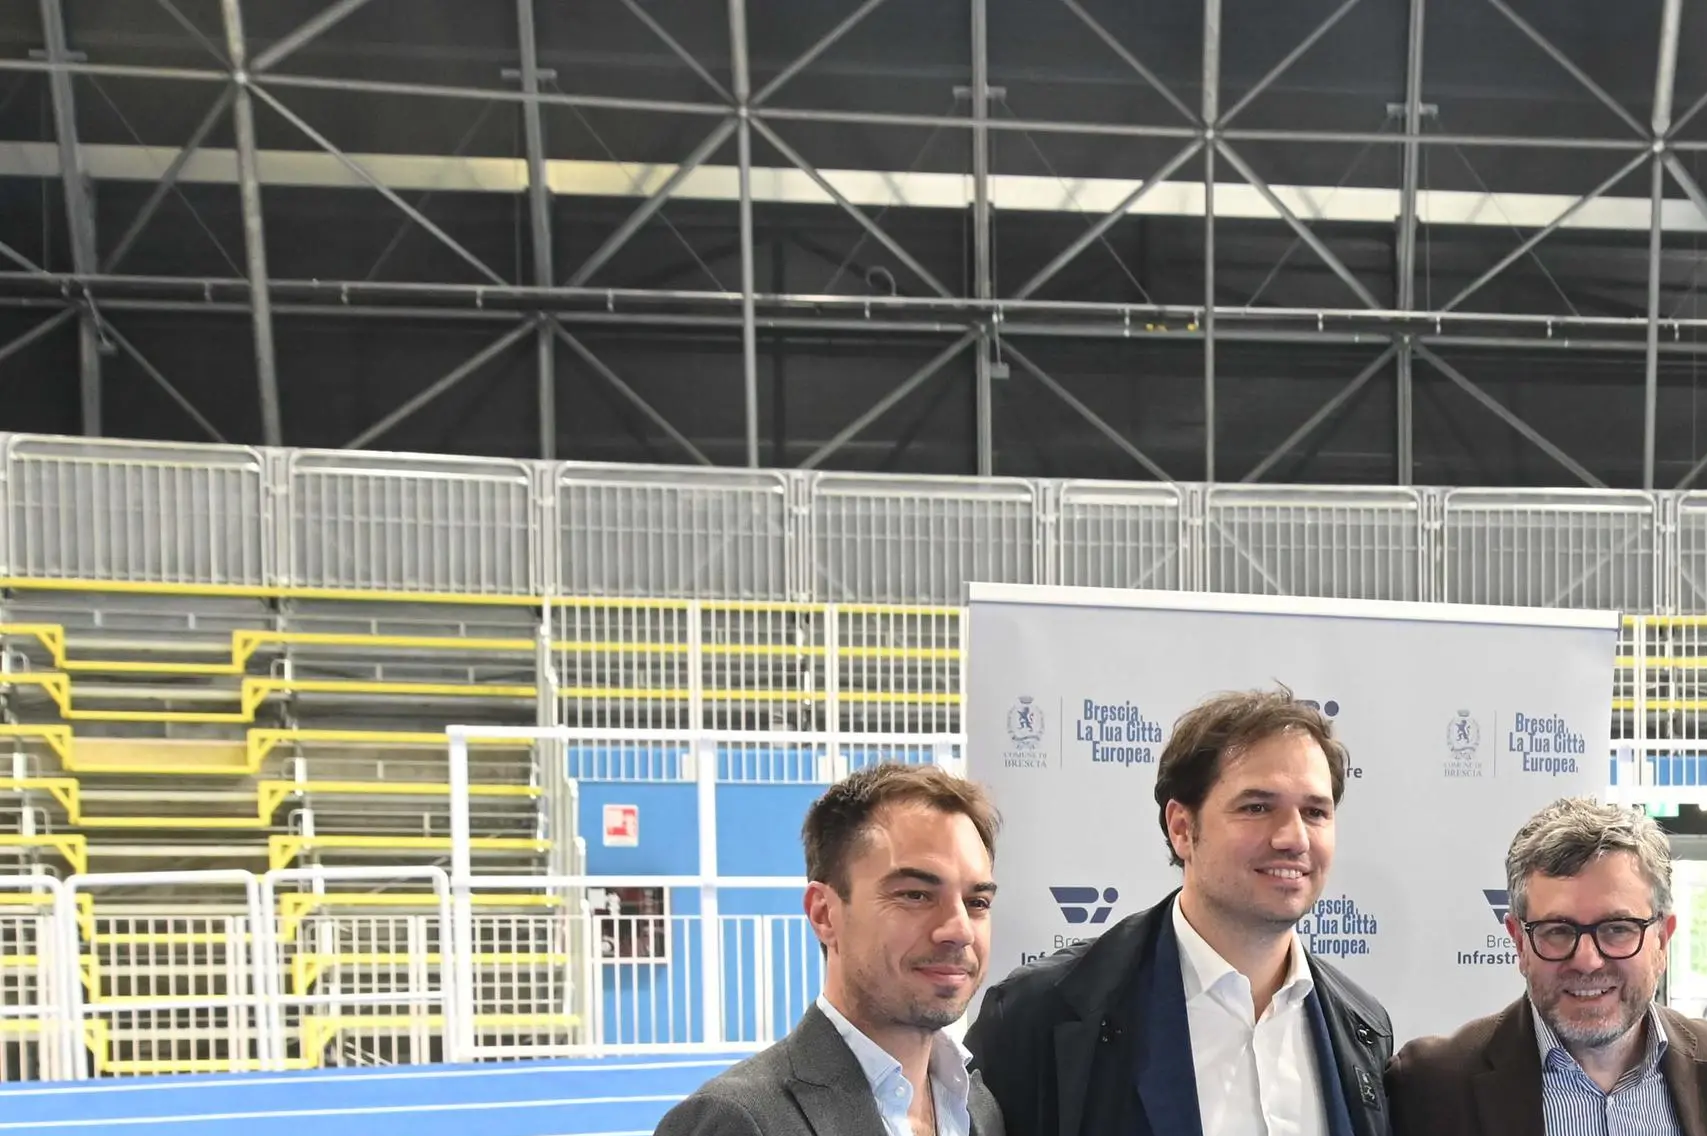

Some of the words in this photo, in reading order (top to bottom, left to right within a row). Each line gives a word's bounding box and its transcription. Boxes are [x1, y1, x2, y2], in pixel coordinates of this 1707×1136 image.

[1077, 719, 1093, 741] La
[1097, 720, 1122, 742] Tua
[1127, 721, 1162, 743] Città
[1509, 731, 1523, 752] La
[1527, 732, 1550, 753] Tua
[1554, 733, 1585, 753] Città
[1310, 894, 1359, 914] rescia.
[1315, 914, 1338, 934] Tua
[1343, 914, 1377, 935] Città
[1458, 951, 1519, 965] Infrastr
